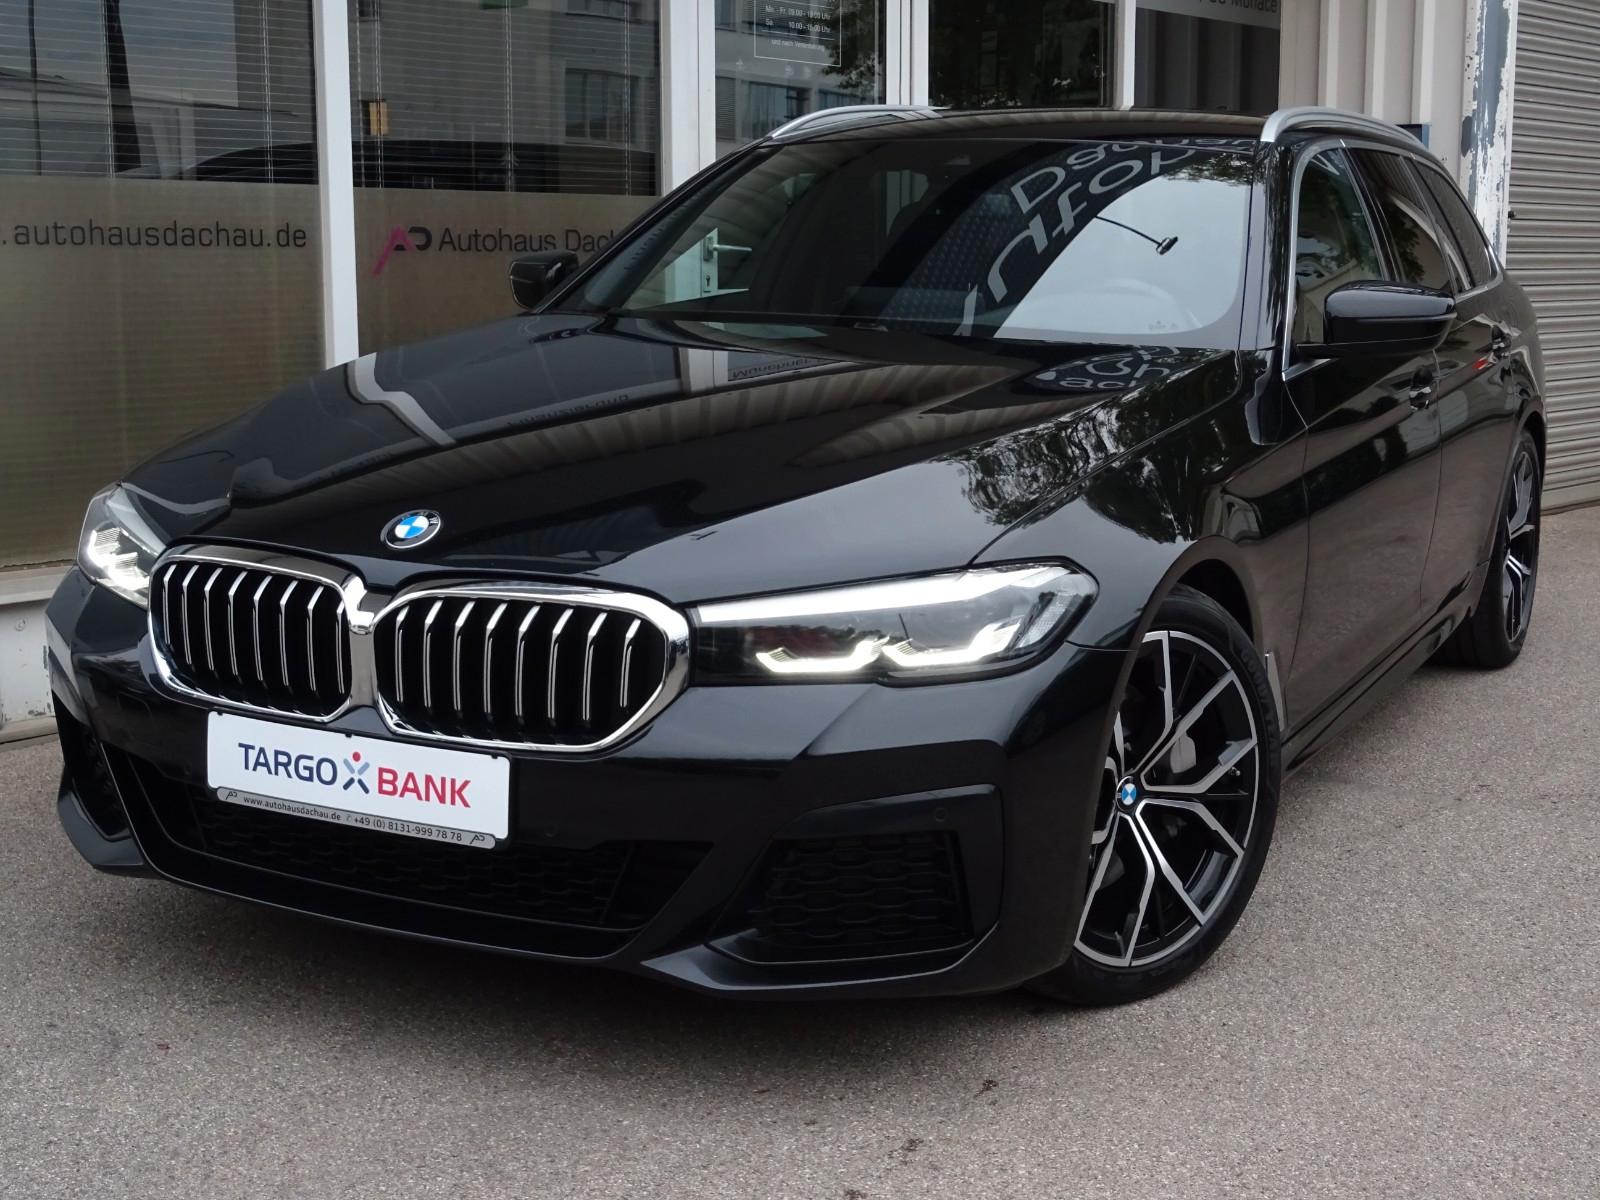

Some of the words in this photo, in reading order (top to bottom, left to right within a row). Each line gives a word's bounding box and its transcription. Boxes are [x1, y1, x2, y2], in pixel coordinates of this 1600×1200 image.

[438, 227, 557, 252] Autohaus
[237, 742, 338, 786] TARGO
[377, 767, 472, 809] BANK
[243, 796, 342, 821] www.autohausdachau.de
[353, 816, 371, 826] +49
[373, 819, 386, 830] (0)
[388, 821, 433, 837] 8131-999
[436, 830, 448, 840] 78
[450, 831, 462, 842] 78
